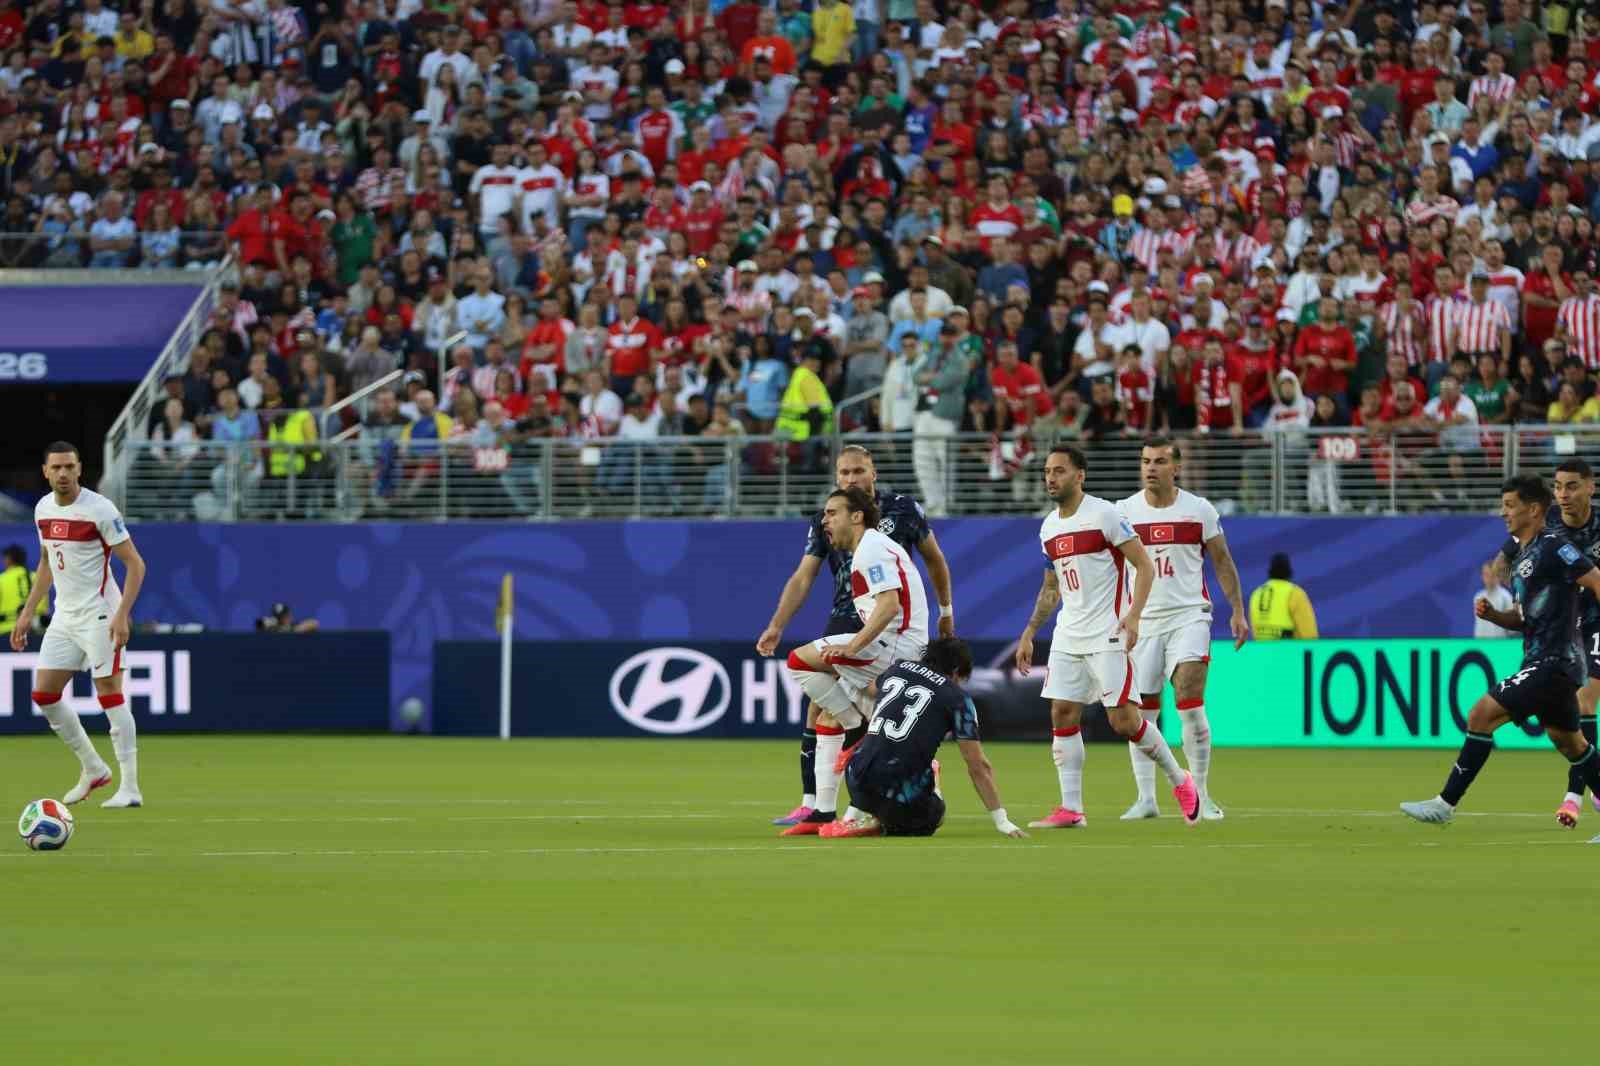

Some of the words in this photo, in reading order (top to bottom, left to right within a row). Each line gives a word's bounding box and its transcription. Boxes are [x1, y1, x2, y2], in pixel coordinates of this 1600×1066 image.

[0, 352, 47, 380] 26
[1323, 438, 1357, 459] 109
[56, 551, 65, 570] 3
[1154, 557, 1175, 578] 14
[1062, 568, 1080, 591] 10
[900, 662, 946, 685] GALARZA
[867, 676, 935, 742] 23
